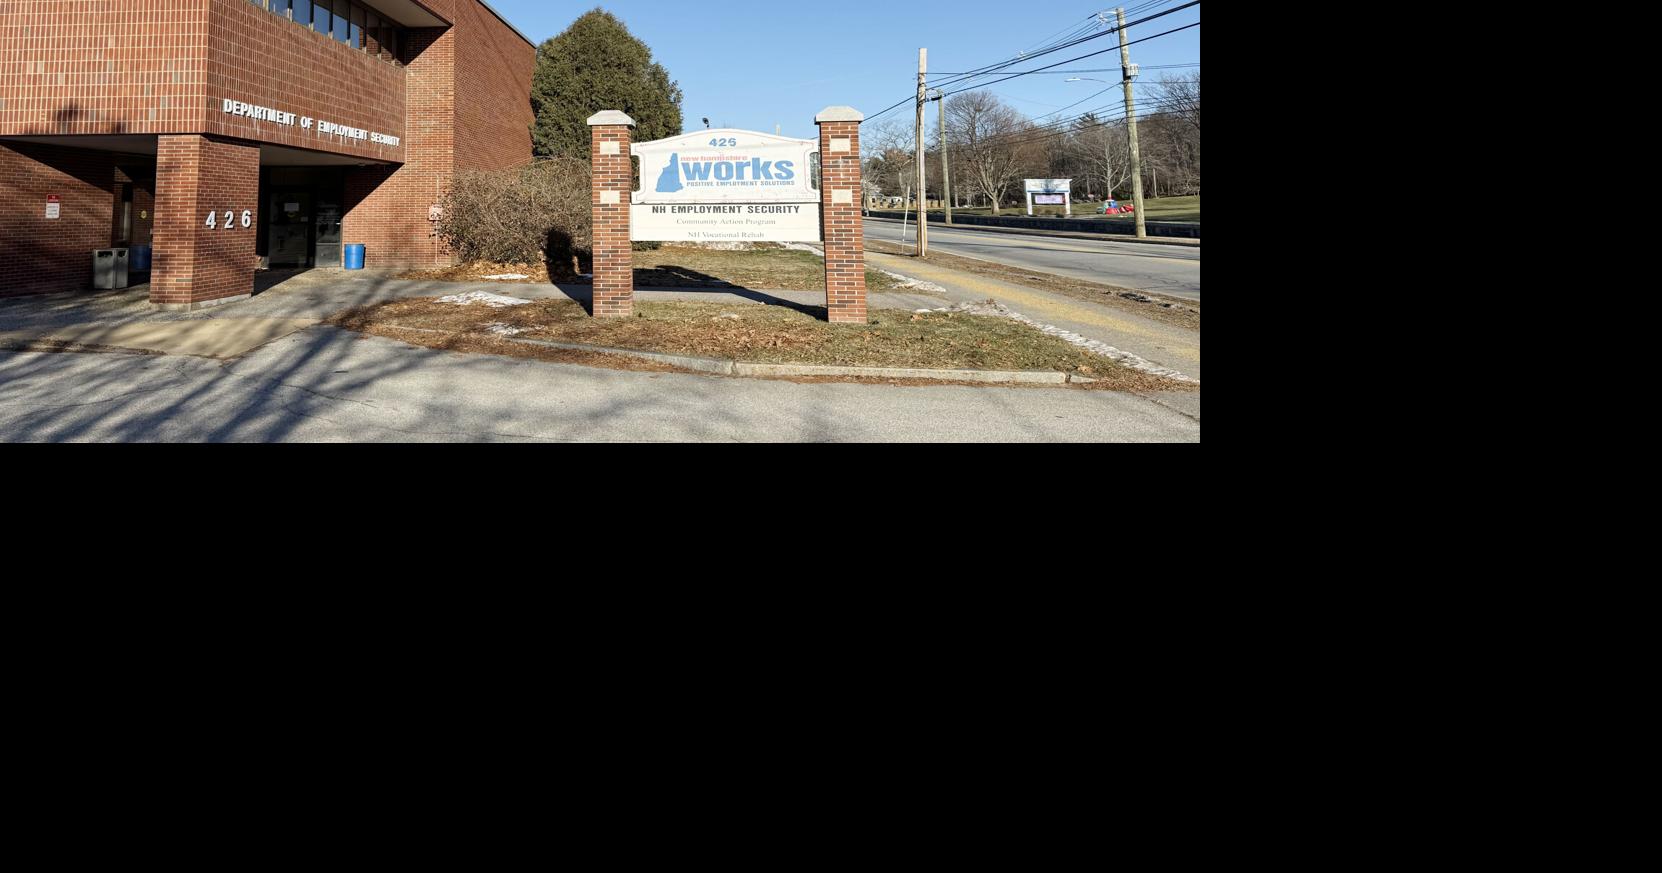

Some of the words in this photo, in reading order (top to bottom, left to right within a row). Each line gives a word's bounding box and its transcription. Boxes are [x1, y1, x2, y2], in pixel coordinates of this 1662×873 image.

[224, 99, 296, 126] DEPARTMENT
[300, 116, 314, 129] OF
[318, 120, 368, 140] EMPLOYMENT
[371, 132, 400, 146] SECURITY
[681, 157, 795, 181] works
[652, 205, 666, 214] NH
[671, 205, 742, 214] EMPLOYMENT
[747, 205, 800, 213] SECURITY
[676, 218, 717, 226] Community
[745, 218, 776, 226] Program
